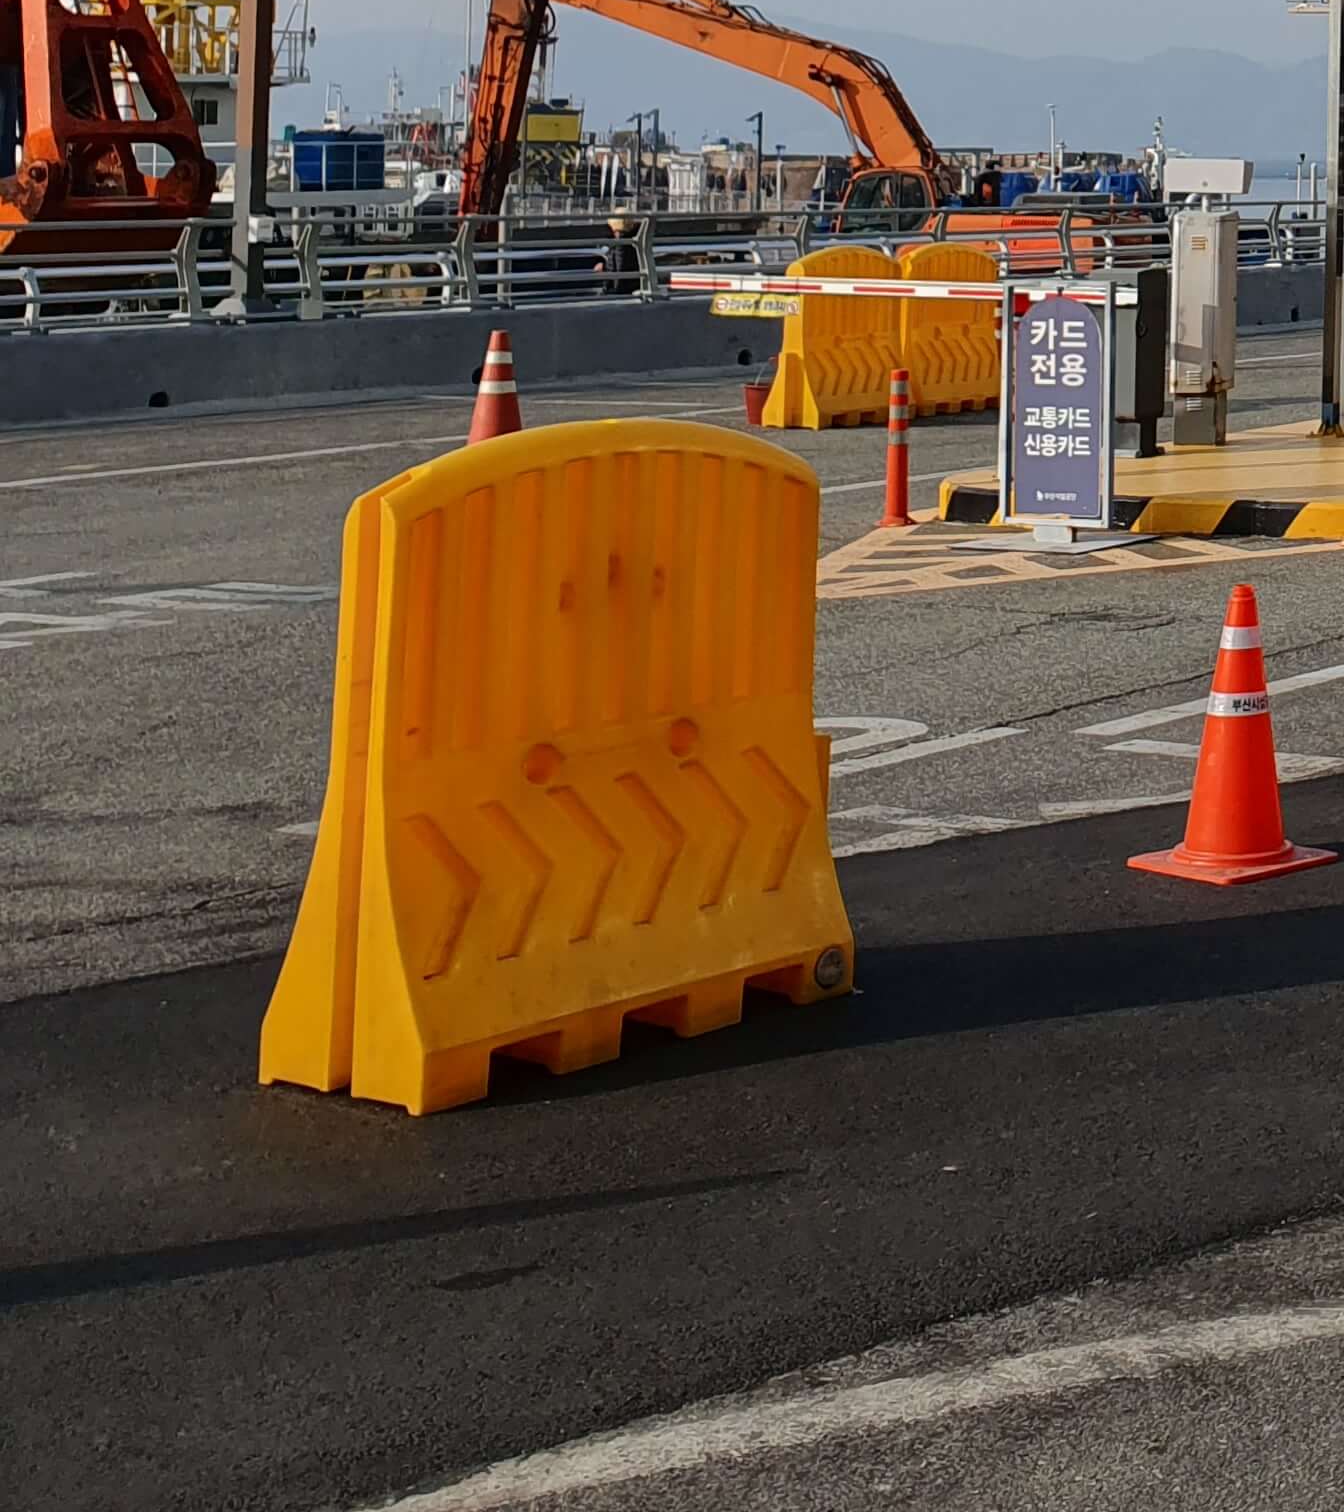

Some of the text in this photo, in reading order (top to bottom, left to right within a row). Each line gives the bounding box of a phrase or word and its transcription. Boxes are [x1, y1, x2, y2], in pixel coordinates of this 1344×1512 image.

[1030, 318, 1088, 350] 카드
[1031, 353, 1088, 387] 전용
[1024, 407, 1091, 429] 교통카드
[1024, 434, 1091, 457] 신용카드
